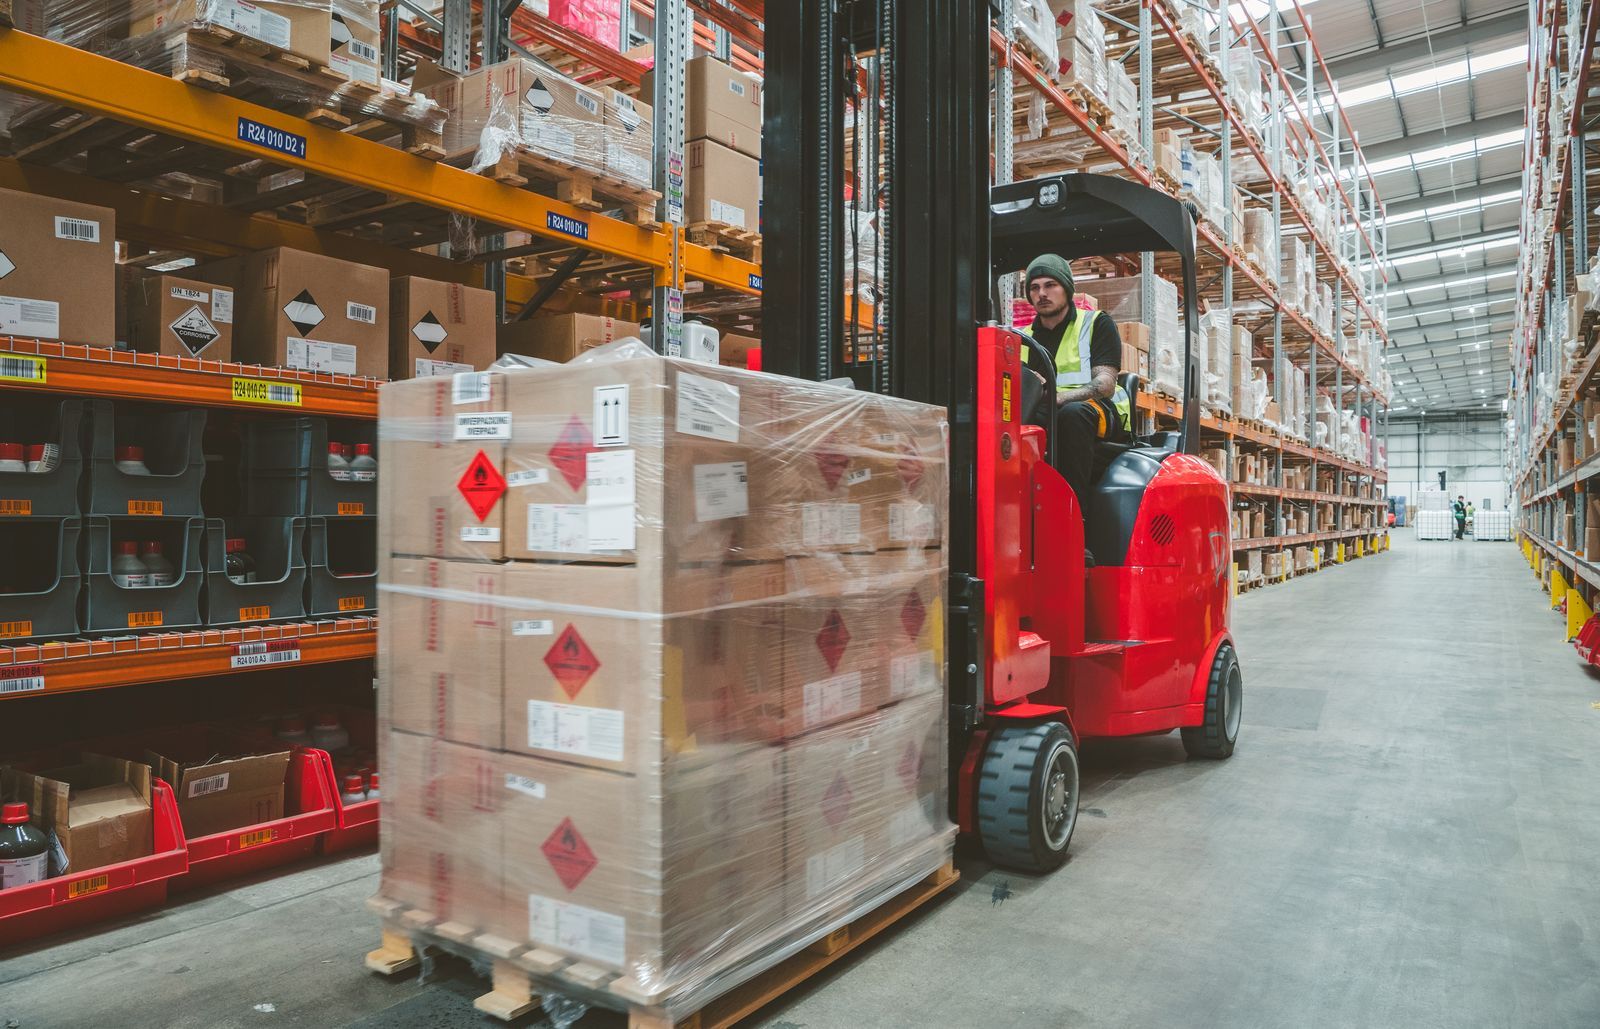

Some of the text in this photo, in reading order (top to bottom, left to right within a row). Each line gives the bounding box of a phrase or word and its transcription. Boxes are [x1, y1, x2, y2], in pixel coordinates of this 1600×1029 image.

[247, 123, 297, 152] R24 010 D2
[552, 215, 582, 235] R24 010 D1
[185, 290, 200, 298] 1824
[179, 330, 210, 340] CORROSIVE
[234, 381, 267, 399] R24 010 C3
[237, 656, 247, 665] R24
[248, 655, 258, 664] 010
[16, 667, 30, 676] 010
